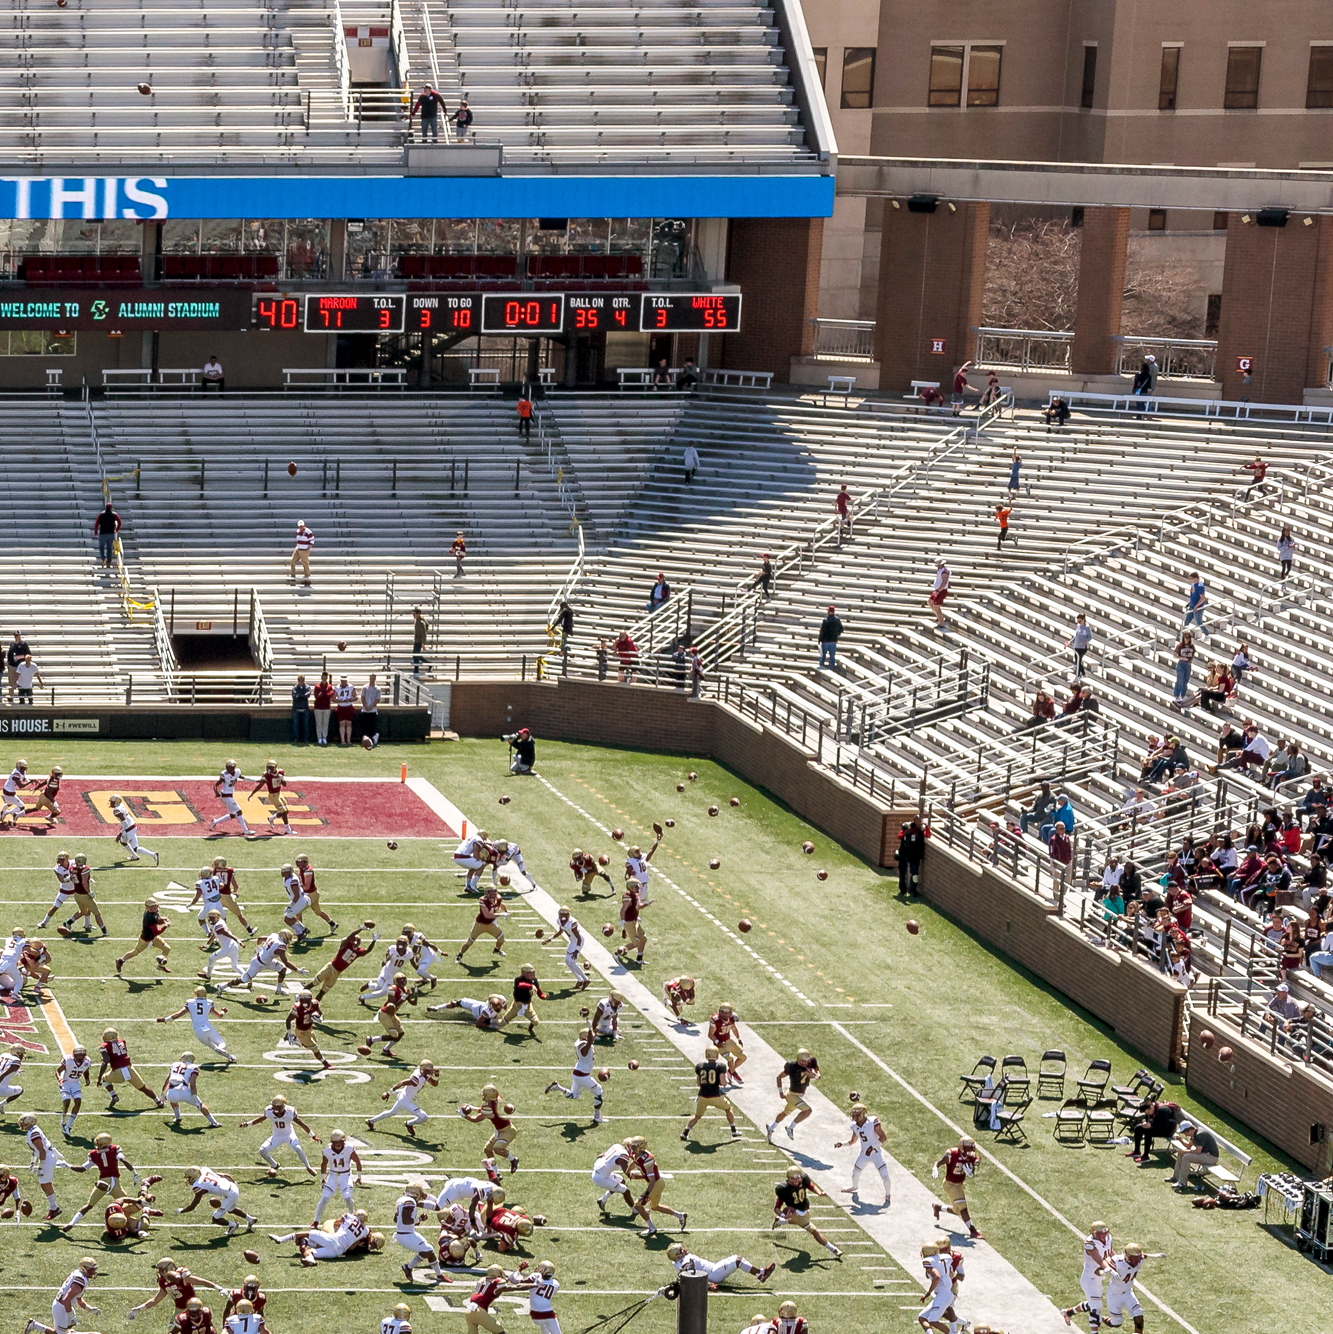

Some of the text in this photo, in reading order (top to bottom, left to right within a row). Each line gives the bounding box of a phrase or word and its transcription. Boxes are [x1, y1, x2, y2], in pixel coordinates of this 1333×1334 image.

[1, 178, 169, 219] THIS
[0, 303, 220, 317] WELCOME TO ALUMNI STADIUM
[320, 298, 357, 309] MAROON
[374, 299, 396, 308] T.O.L.
[413, 298, 438, 308] DOWN
[448, 298, 472, 308] TO GO
[570, 298, 604, 308] BALL ON
[612, 298, 631, 308] QTR.
[652, 298, 674, 307] T.O.L.
[692, 297, 723, 308] WHITE
[260, 300, 296, 328] 40
[320, 310, 341, 327] 71
[380, 310, 389, 328] 3
[420, 310, 430, 328] 3
[453, 310, 470, 328] 10
[506, 302, 557, 325] 0:01
[576, 310, 597, 328] 35
[615, 310, 625, 326] 4
[656, 310, 666, 327] 3
[705, 310, 726, 327] 55
[11, 719, 51, 732] HOUSE.
